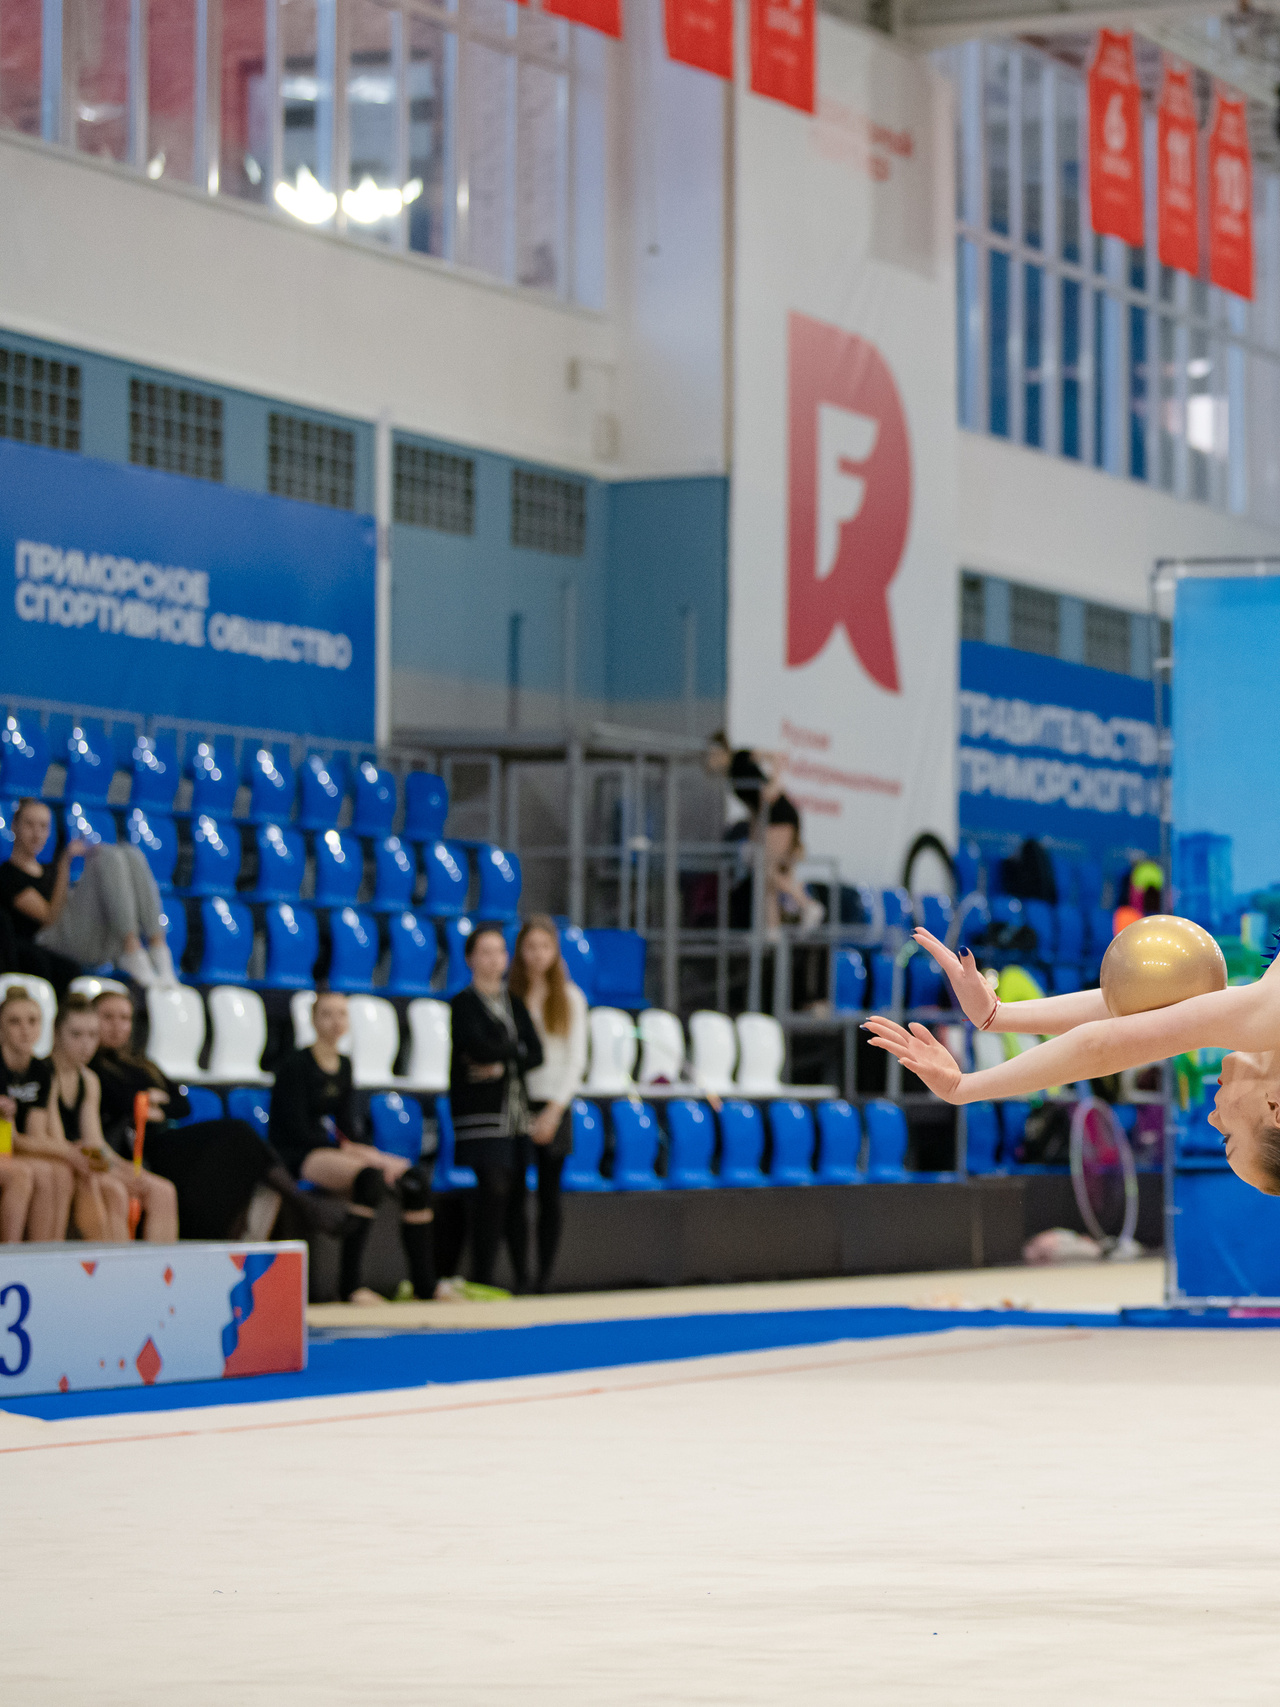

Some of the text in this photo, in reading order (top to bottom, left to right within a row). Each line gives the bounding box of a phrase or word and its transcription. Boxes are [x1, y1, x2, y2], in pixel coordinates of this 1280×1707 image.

[15, 538, 209, 608] ПРИМОРСКОЕ
[15, 580, 353, 671] СПОРТИВНОЕ ОБЩЕСТВО
[0, 1282, 31, 1377] 3
